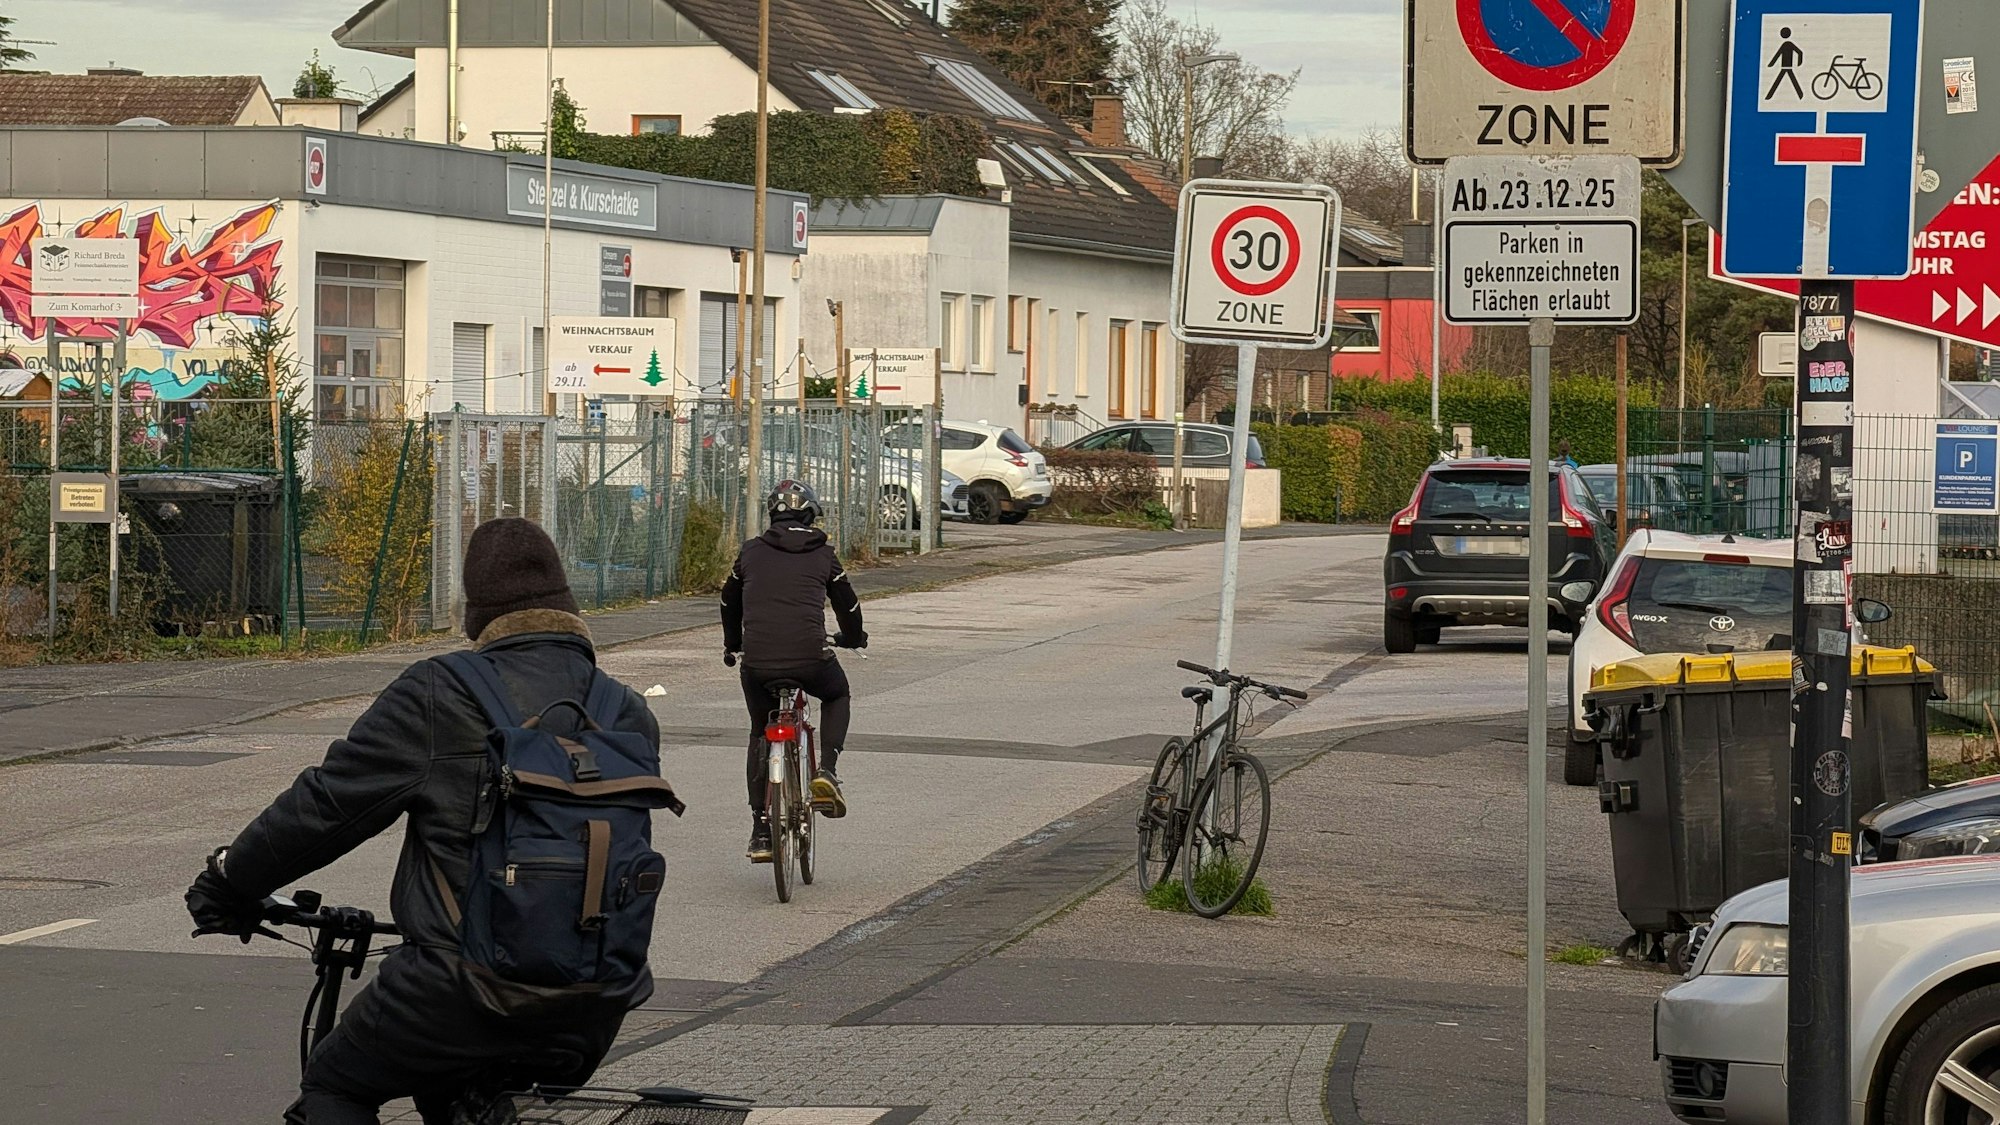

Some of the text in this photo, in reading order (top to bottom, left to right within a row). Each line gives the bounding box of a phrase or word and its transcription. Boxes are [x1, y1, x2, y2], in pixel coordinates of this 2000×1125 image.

[1476, 104, 1610, 145] ZONE
[527, 177, 639, 217] Stezel & Kurschatke
[1499, 231, 1583, 254] Parken in
[74, 251, 125, 260] Richard Breda
[1229, 229, 1281, 272] 30
[1464, 259, 1619, 288] gekennzeichneten
[49, 302, 69, 311] Zum
[71, 303, 114, 312] Komarhof
[1472, 288, 1610, 311] Flächen erlaubt
[1801, 295, 1838, 310] 7877
[1216, 300, 1285, 325] ZONE
[562, 326, 655, 336] WEIHNACHTSBAUM
[588, 345, 633, 354] VERKAUF
[564, 362, 577, 372] ab
[876, 365, 908, 373] ERKAUF
[554, 376, 586, 387] 29.11.
[1959, 450, 1973, 468] P
[63, 486, 103, 494] Privatgrundstück
